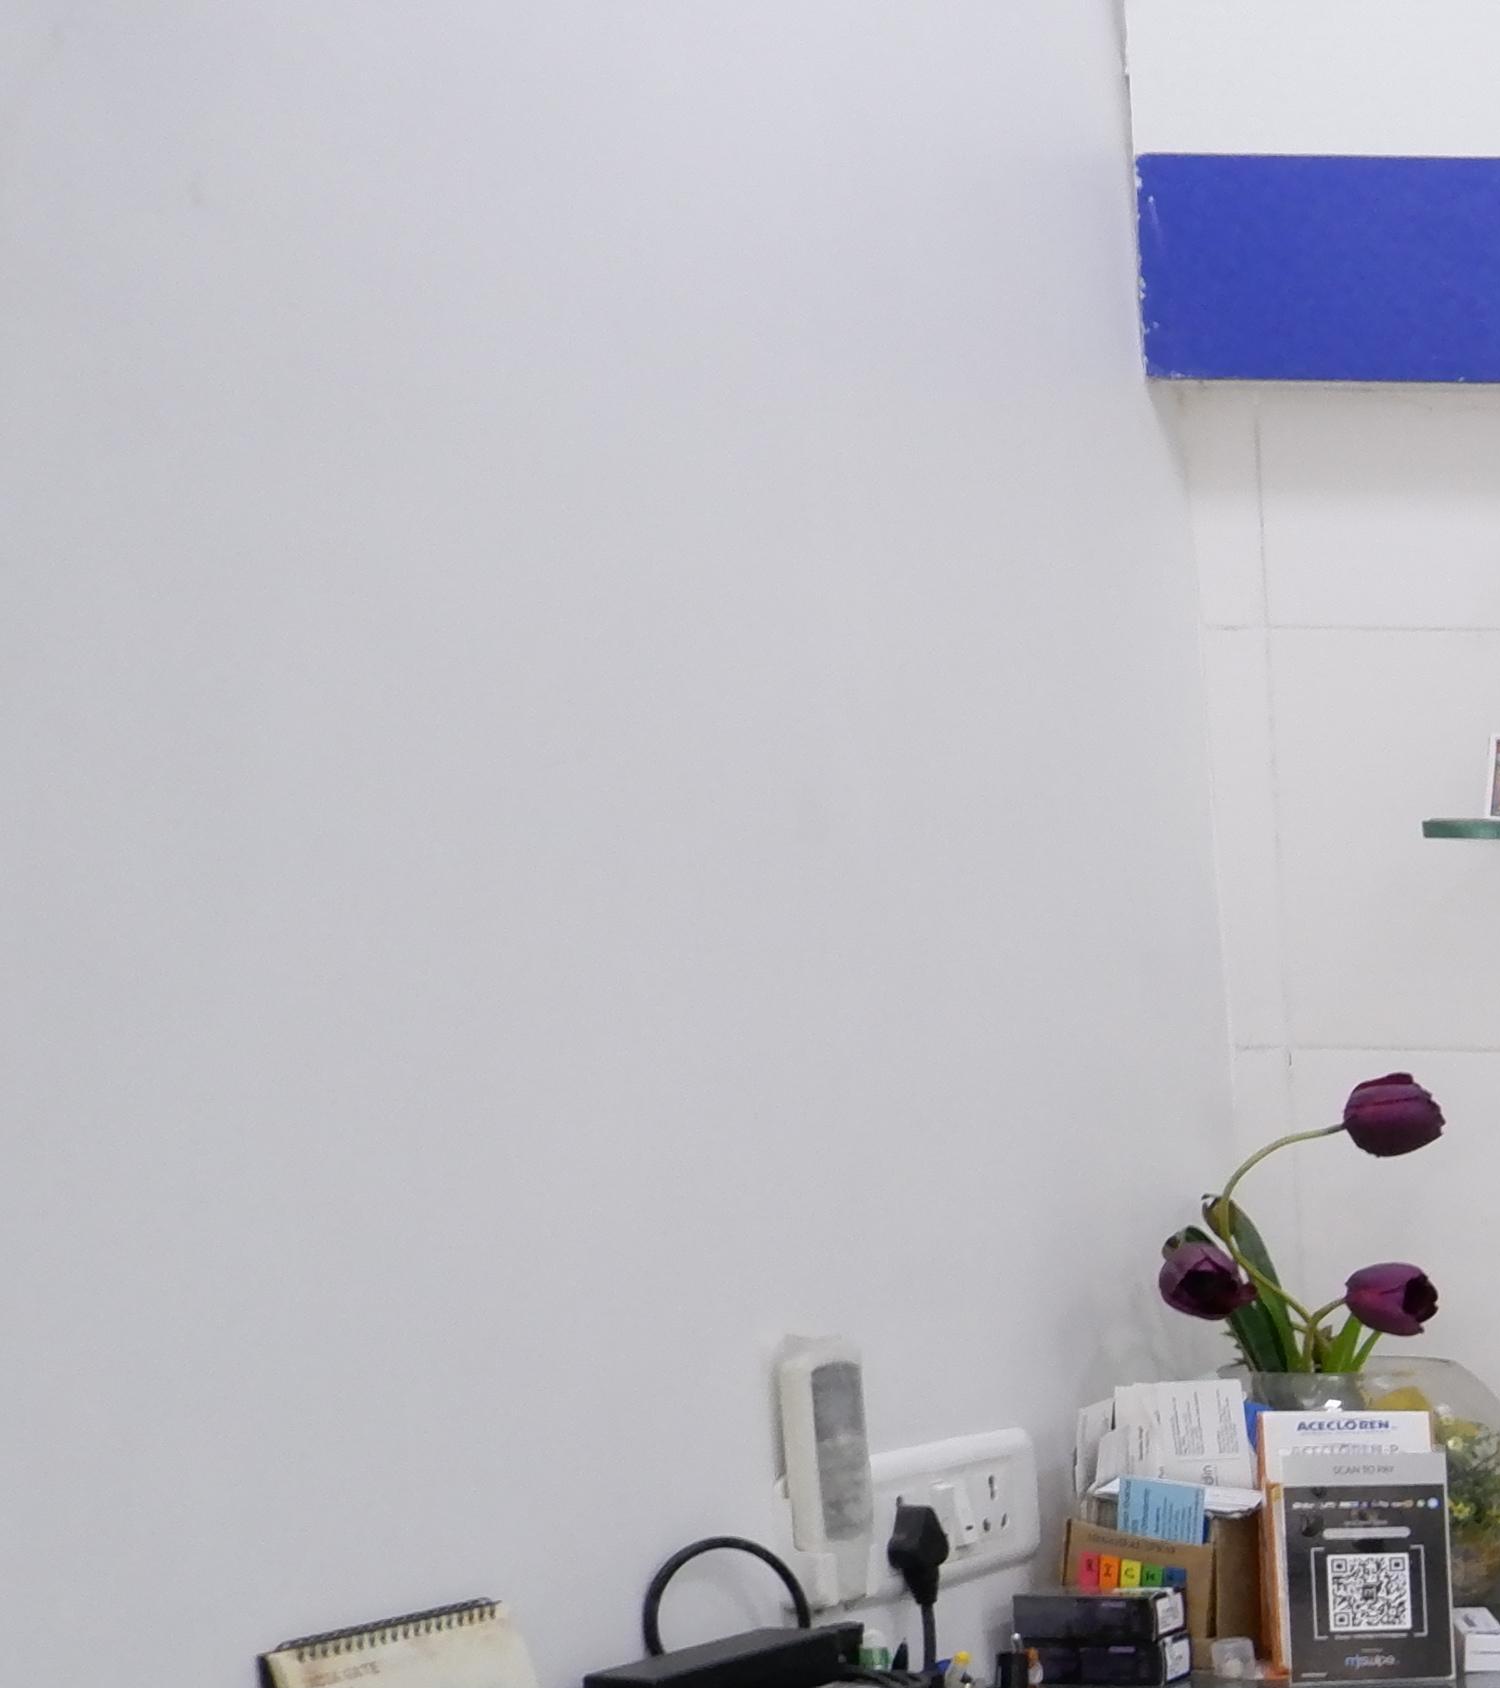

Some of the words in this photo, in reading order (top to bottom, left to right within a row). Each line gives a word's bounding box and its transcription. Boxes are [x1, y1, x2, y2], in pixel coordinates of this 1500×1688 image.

[1332, 1464, 1361, 1475] SCAN
[1362, 1464, 1376, 1475] TO
[1377, 1464, 1395, 1474] PAY
